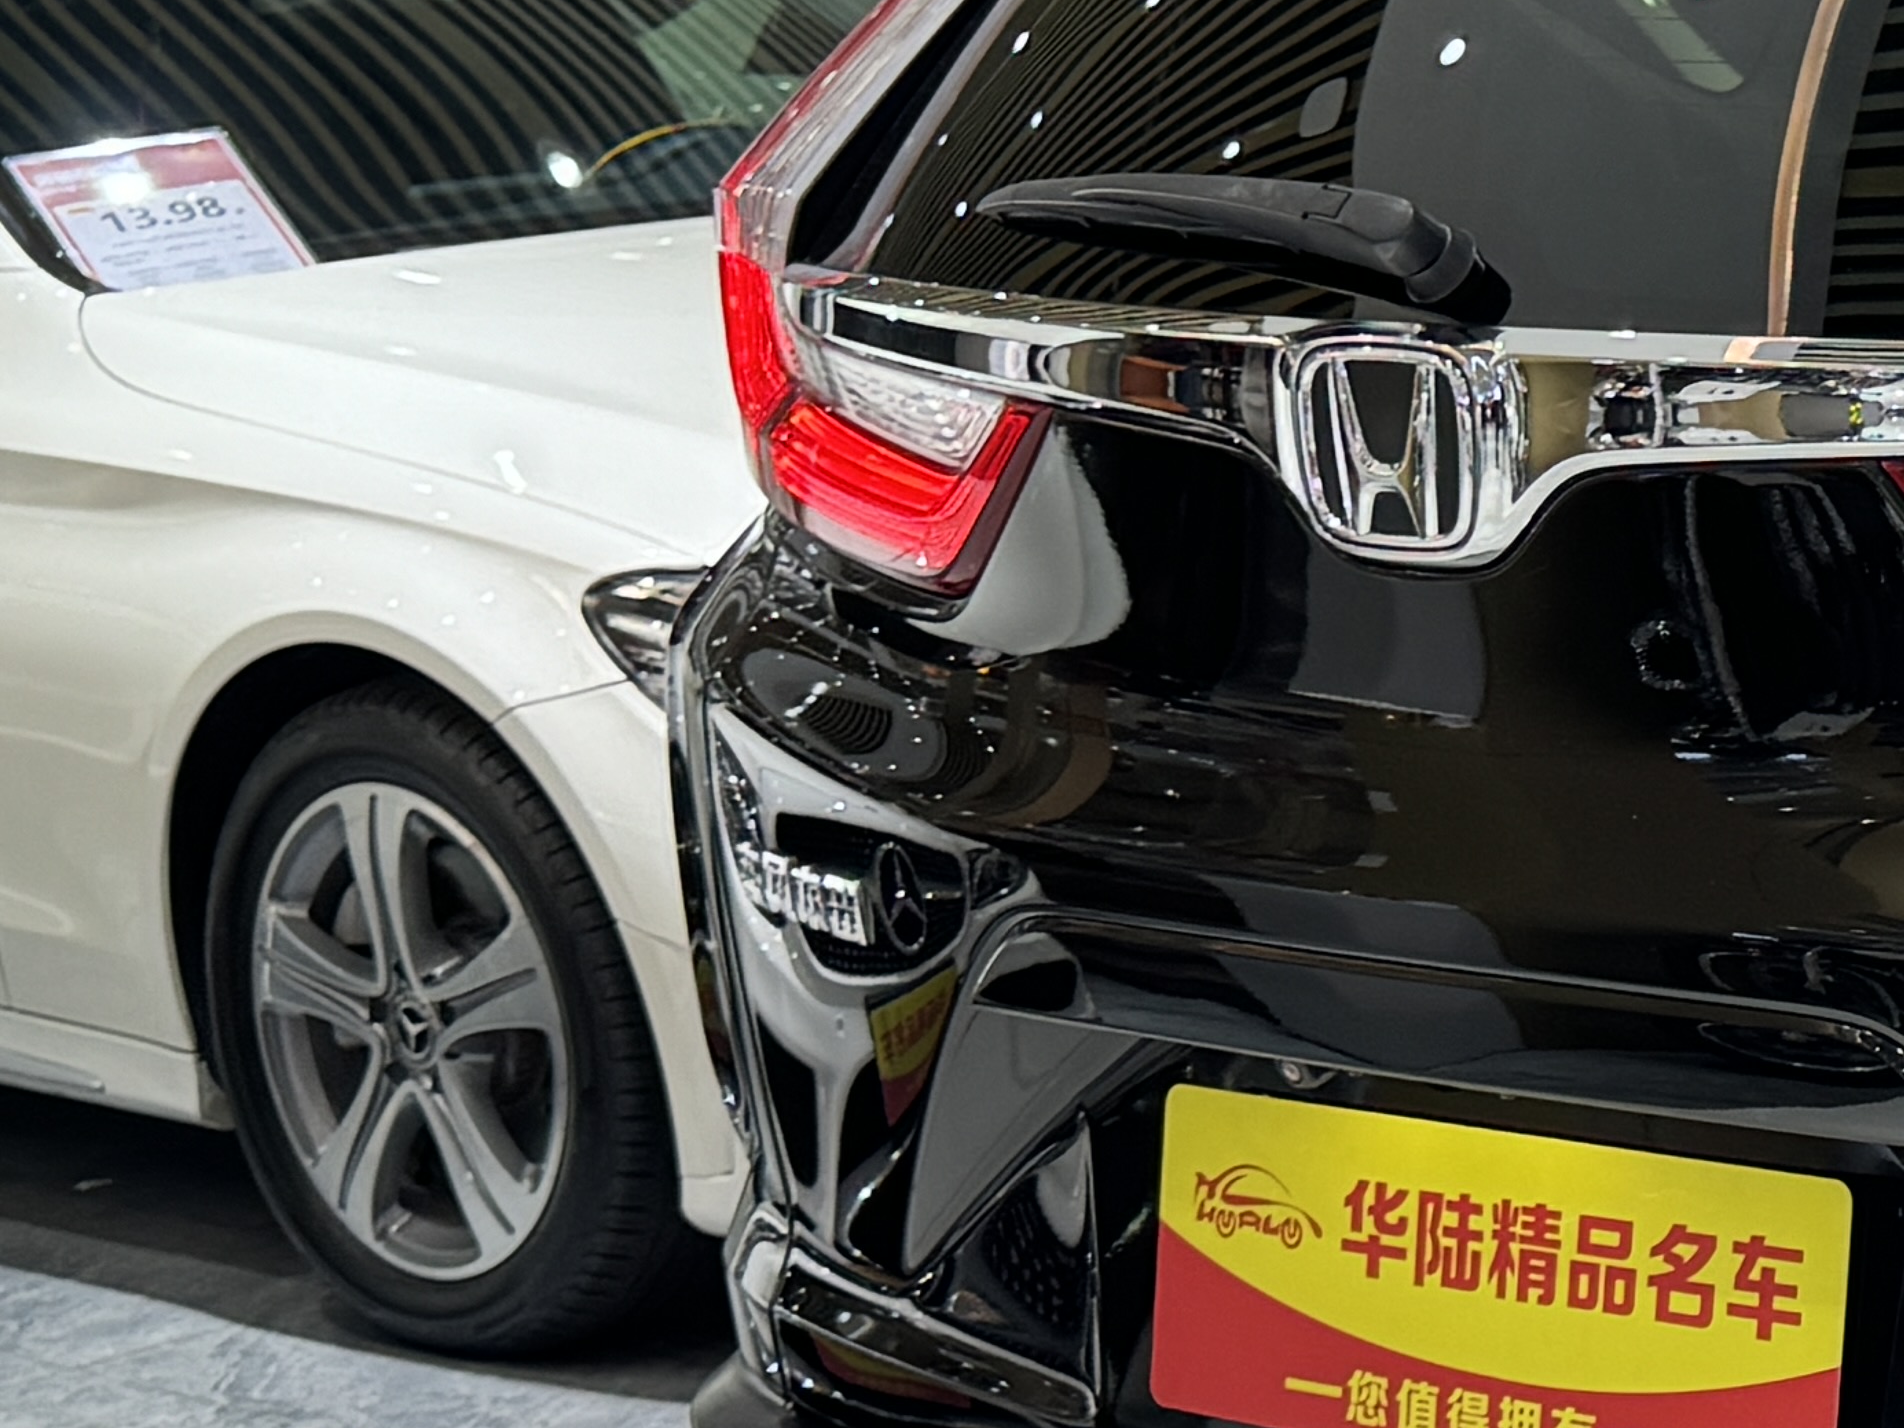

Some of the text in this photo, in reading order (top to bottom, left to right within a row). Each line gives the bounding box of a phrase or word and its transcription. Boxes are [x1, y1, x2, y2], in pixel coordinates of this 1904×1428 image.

[101, 195, 227, 233] 13.98
[1341, 1179, 1804, 1342] 华陆精品名车
